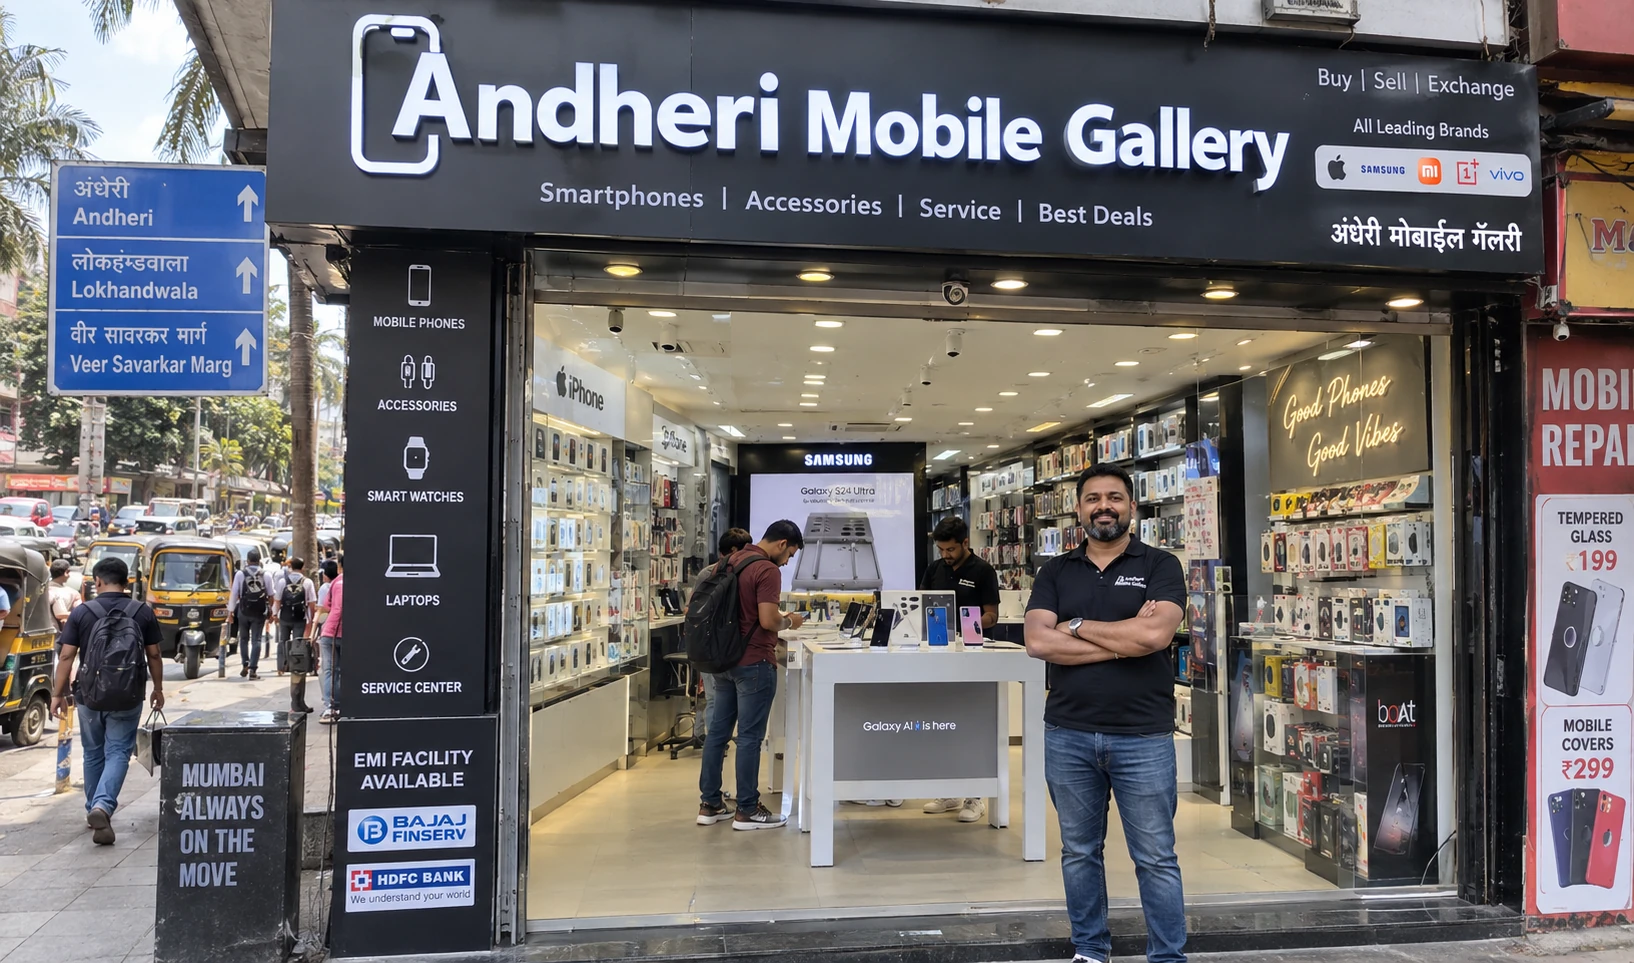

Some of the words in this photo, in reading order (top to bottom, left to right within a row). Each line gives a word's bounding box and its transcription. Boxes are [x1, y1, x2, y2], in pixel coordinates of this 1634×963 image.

[1318, 68, 1352, 92] Buy
[1374, 72, 1407, 90] Sell
[1428, 75, 1515, 100] Exchange
[391, 52, 779, 152] Andheri
[807, 89, 1043, 163] Mobile
[1065, 103, 1290, 193] Gallery
[1353, 118, 1372, 133] All
[1377, 119, 1435, 140] Leading
[1440, 122, 1489, 138] Brands
[1361, 165, 1405, 175] SAMSUNG
[1490, 167, 1524, 181] vivo
[74, 176, 130, 198] अंधेरी
[540, 182, 704, 210] Smartphones
[745, 190, 882, 215] Accessories
[920, 198, 1001, 220] Service
[1039, 203, 1086, 224] Best
[1094, 205, 1153, 226] Deals
[73, 207, 153, 226] Andheri
[1331, 216, 1382, 246] अंधेरी
[1388, 217, 1465, 253] मोबाईल
[1472, 222, 1522, 252] गॅलरी
[72, 280, 198, 300] Lokhandwala
[373, 316, 416, 328] MOBILE
[419, 317, 465, 329] PHONES
[70, 320, 97, 344] वीर
[104, 327, 169, 344] सावरकर
[176, 322, 207, 345] मार्ग
[70, 354, 108, 373] Veer
[112, 354, 186, 373] Savarkar
[191, 355, 232, 378] Marg
[569, 374, 604, 411] iPhone
[1542, 368, 1634, 411] MOBI
[377, 399, 457, 412] ACCESSORIES
[1283, 386, 1324, 439] Good
[1327, 374, 1391, 417] Phones
[1307, 425, 1349, 477] Good
[1356, 413, 1403, 457] Vibes
[804, 453, 873, 467] SAMSUNG
[367, 490, 407, 502] SMART
[410, 491, 464, 502] WATCHES
[800, 487, 834, 498] Galaxy
[835, 487, 852, 496] S24
[853, 487, 876, 496] Ultra
[1558, 511, 1623, 525] TEMPERED
[1571, 530, 1612, 543] GLASS
[386, 595, 440, 606] LAPTOPS
[361, 682, 411, 694] SERVICE
[414, 682, 462, 693] CENTER
[863, 721, 901, 733] Galaxy
[903, 721, 913, 730] AI
[922, 721, 931, 730] is
[932, 721, 956, 730] here
[1564, 719, 1612, 732] MOBILE
[1562, 737, 1614, 751] COVERS
[354, 752, 386, 767] EMI
[392, 750, 473, 767] FACILITY
[182, 763, 264, 787] MUMBAI
[1562, 757, 1614, 779] ₹299
[360, 772, 464, 789] AVAILABLE
[180, 795, 264, 820] ALWAYS
[393, 813, 466, 828] BAJAJ
[180, 829, 208, 854] ON
[215, 828, 255, 853] THE
[392, 829, 466, 843] FINSERV
[179, 862, 238, 887] MOVE
[377, 873, 418, 886] HDFC
[423, 870, 465, 883] BANK
[351, 894, 366, 904] We
[369, 891, 421, 903] understand
[423, 892, 444, 901] your
[446, 889, 471, 899] world
